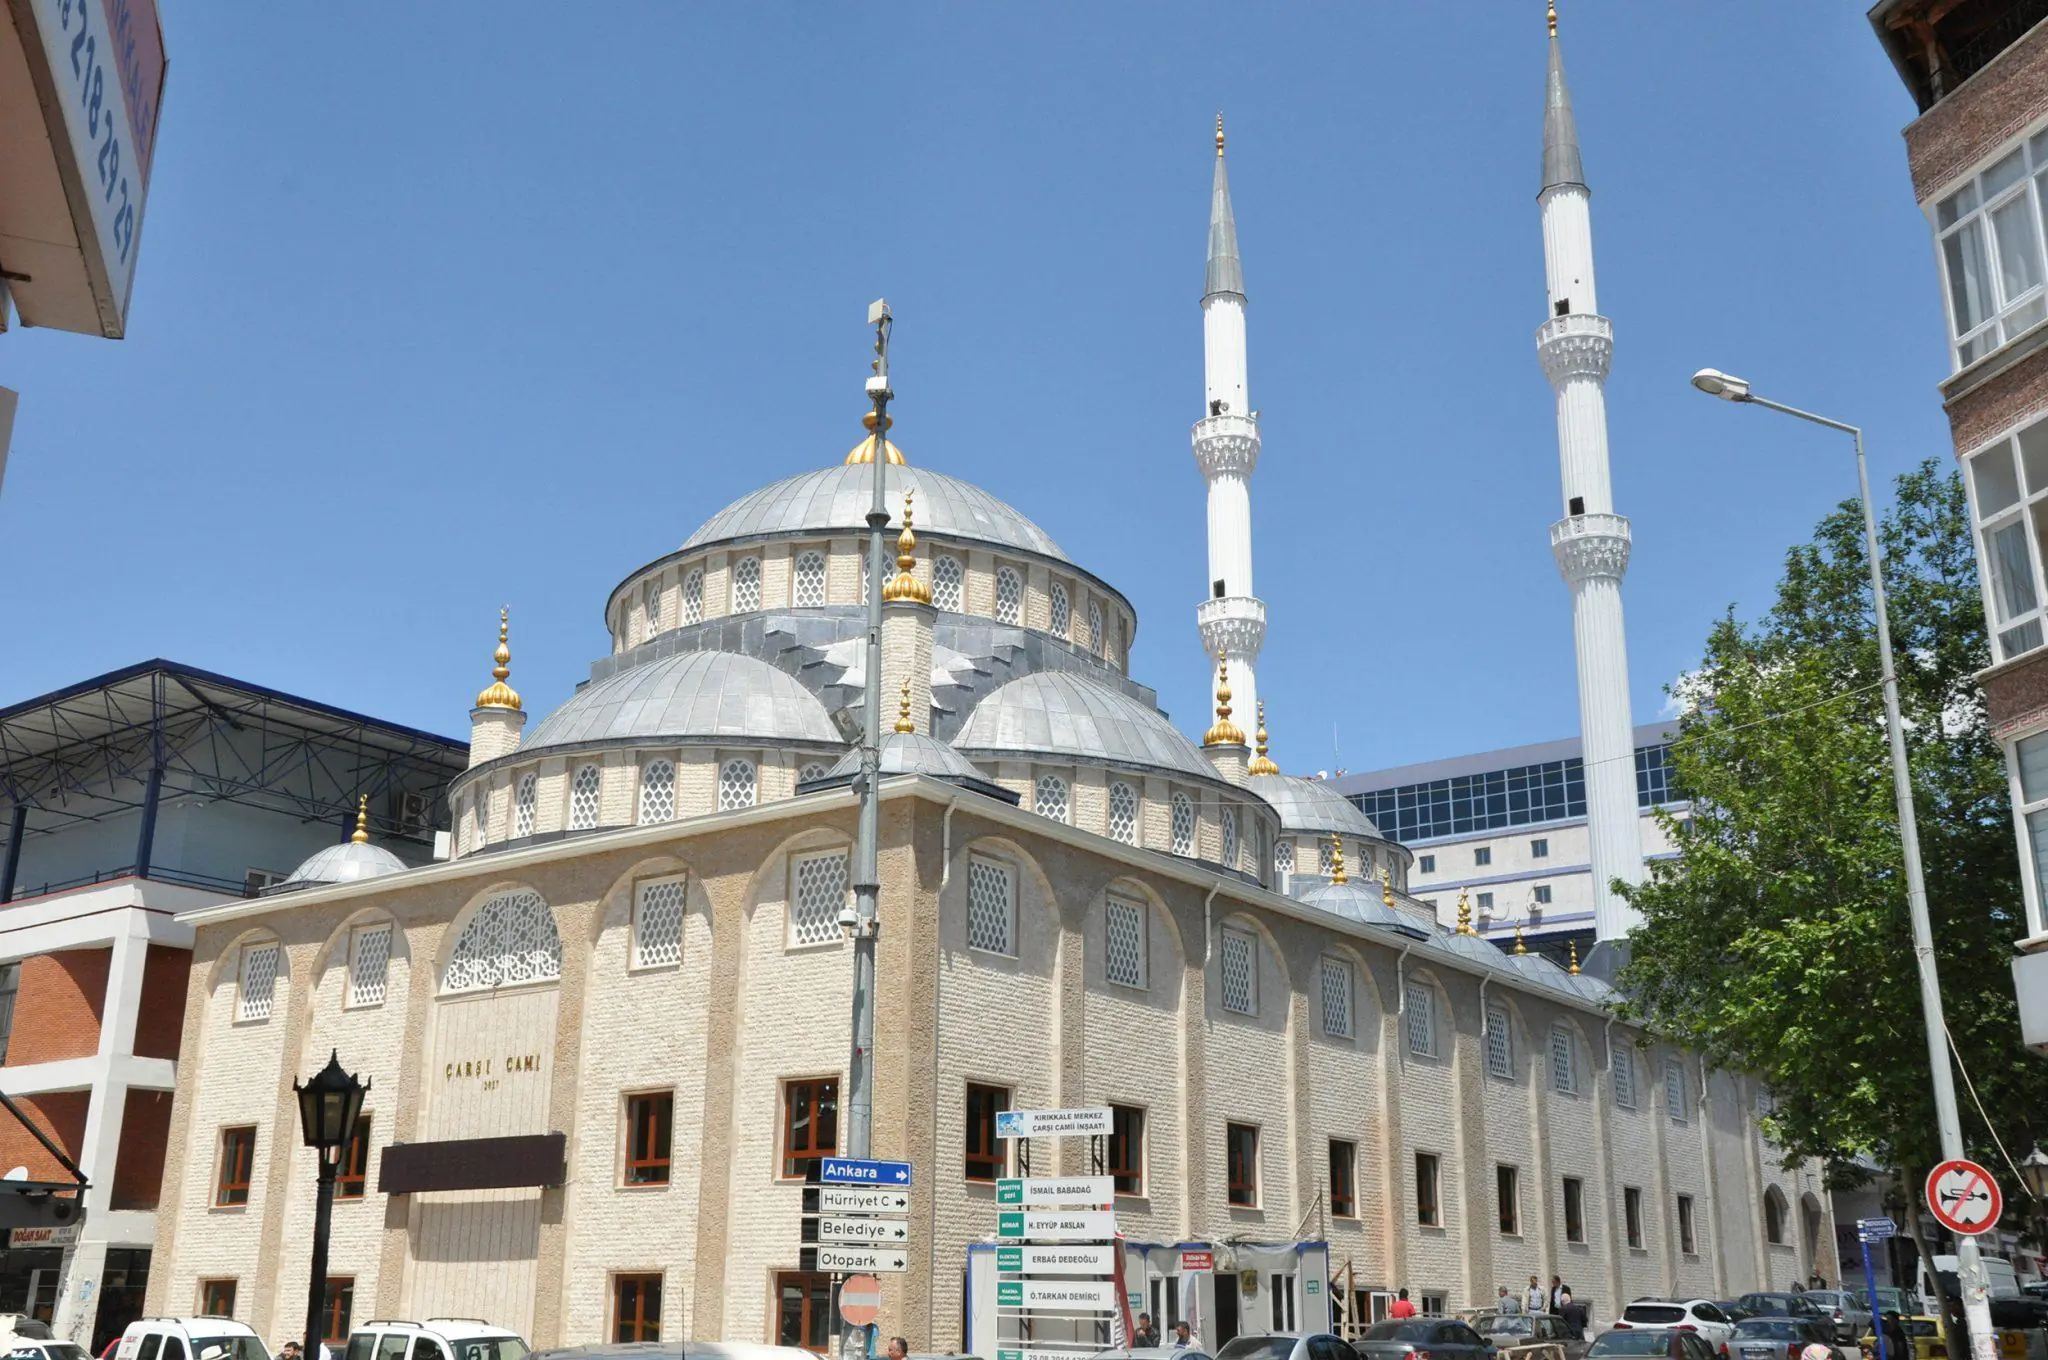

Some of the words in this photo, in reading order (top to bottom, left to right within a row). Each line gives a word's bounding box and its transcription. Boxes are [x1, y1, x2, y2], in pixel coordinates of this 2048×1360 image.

[98, 109, 120, 204] 29
[114, 177, 133, 266] 29
[1074, 1112, 1103, 1120] MERKEZ
[1032, 1124, 1053, 1132] ÇARŞI
[826, 1163, 877, 1178] Ankara
[1030, 1186, 1055, 1194] İSMAİL
[1056, 1186, 1091, 1194] BABADAĞ
[825, 1193, 878, 1208] Hürriyet
[881, 1196, 890, 1206] C
[823, 1222, 885, 1238] Belediye
[822, 1253, 876, 1268] Otopark
[1032, 1254, 1057, 1263] ERBAĞ
[1058, 1254, 1098, 1263] DEDEOĞLU
